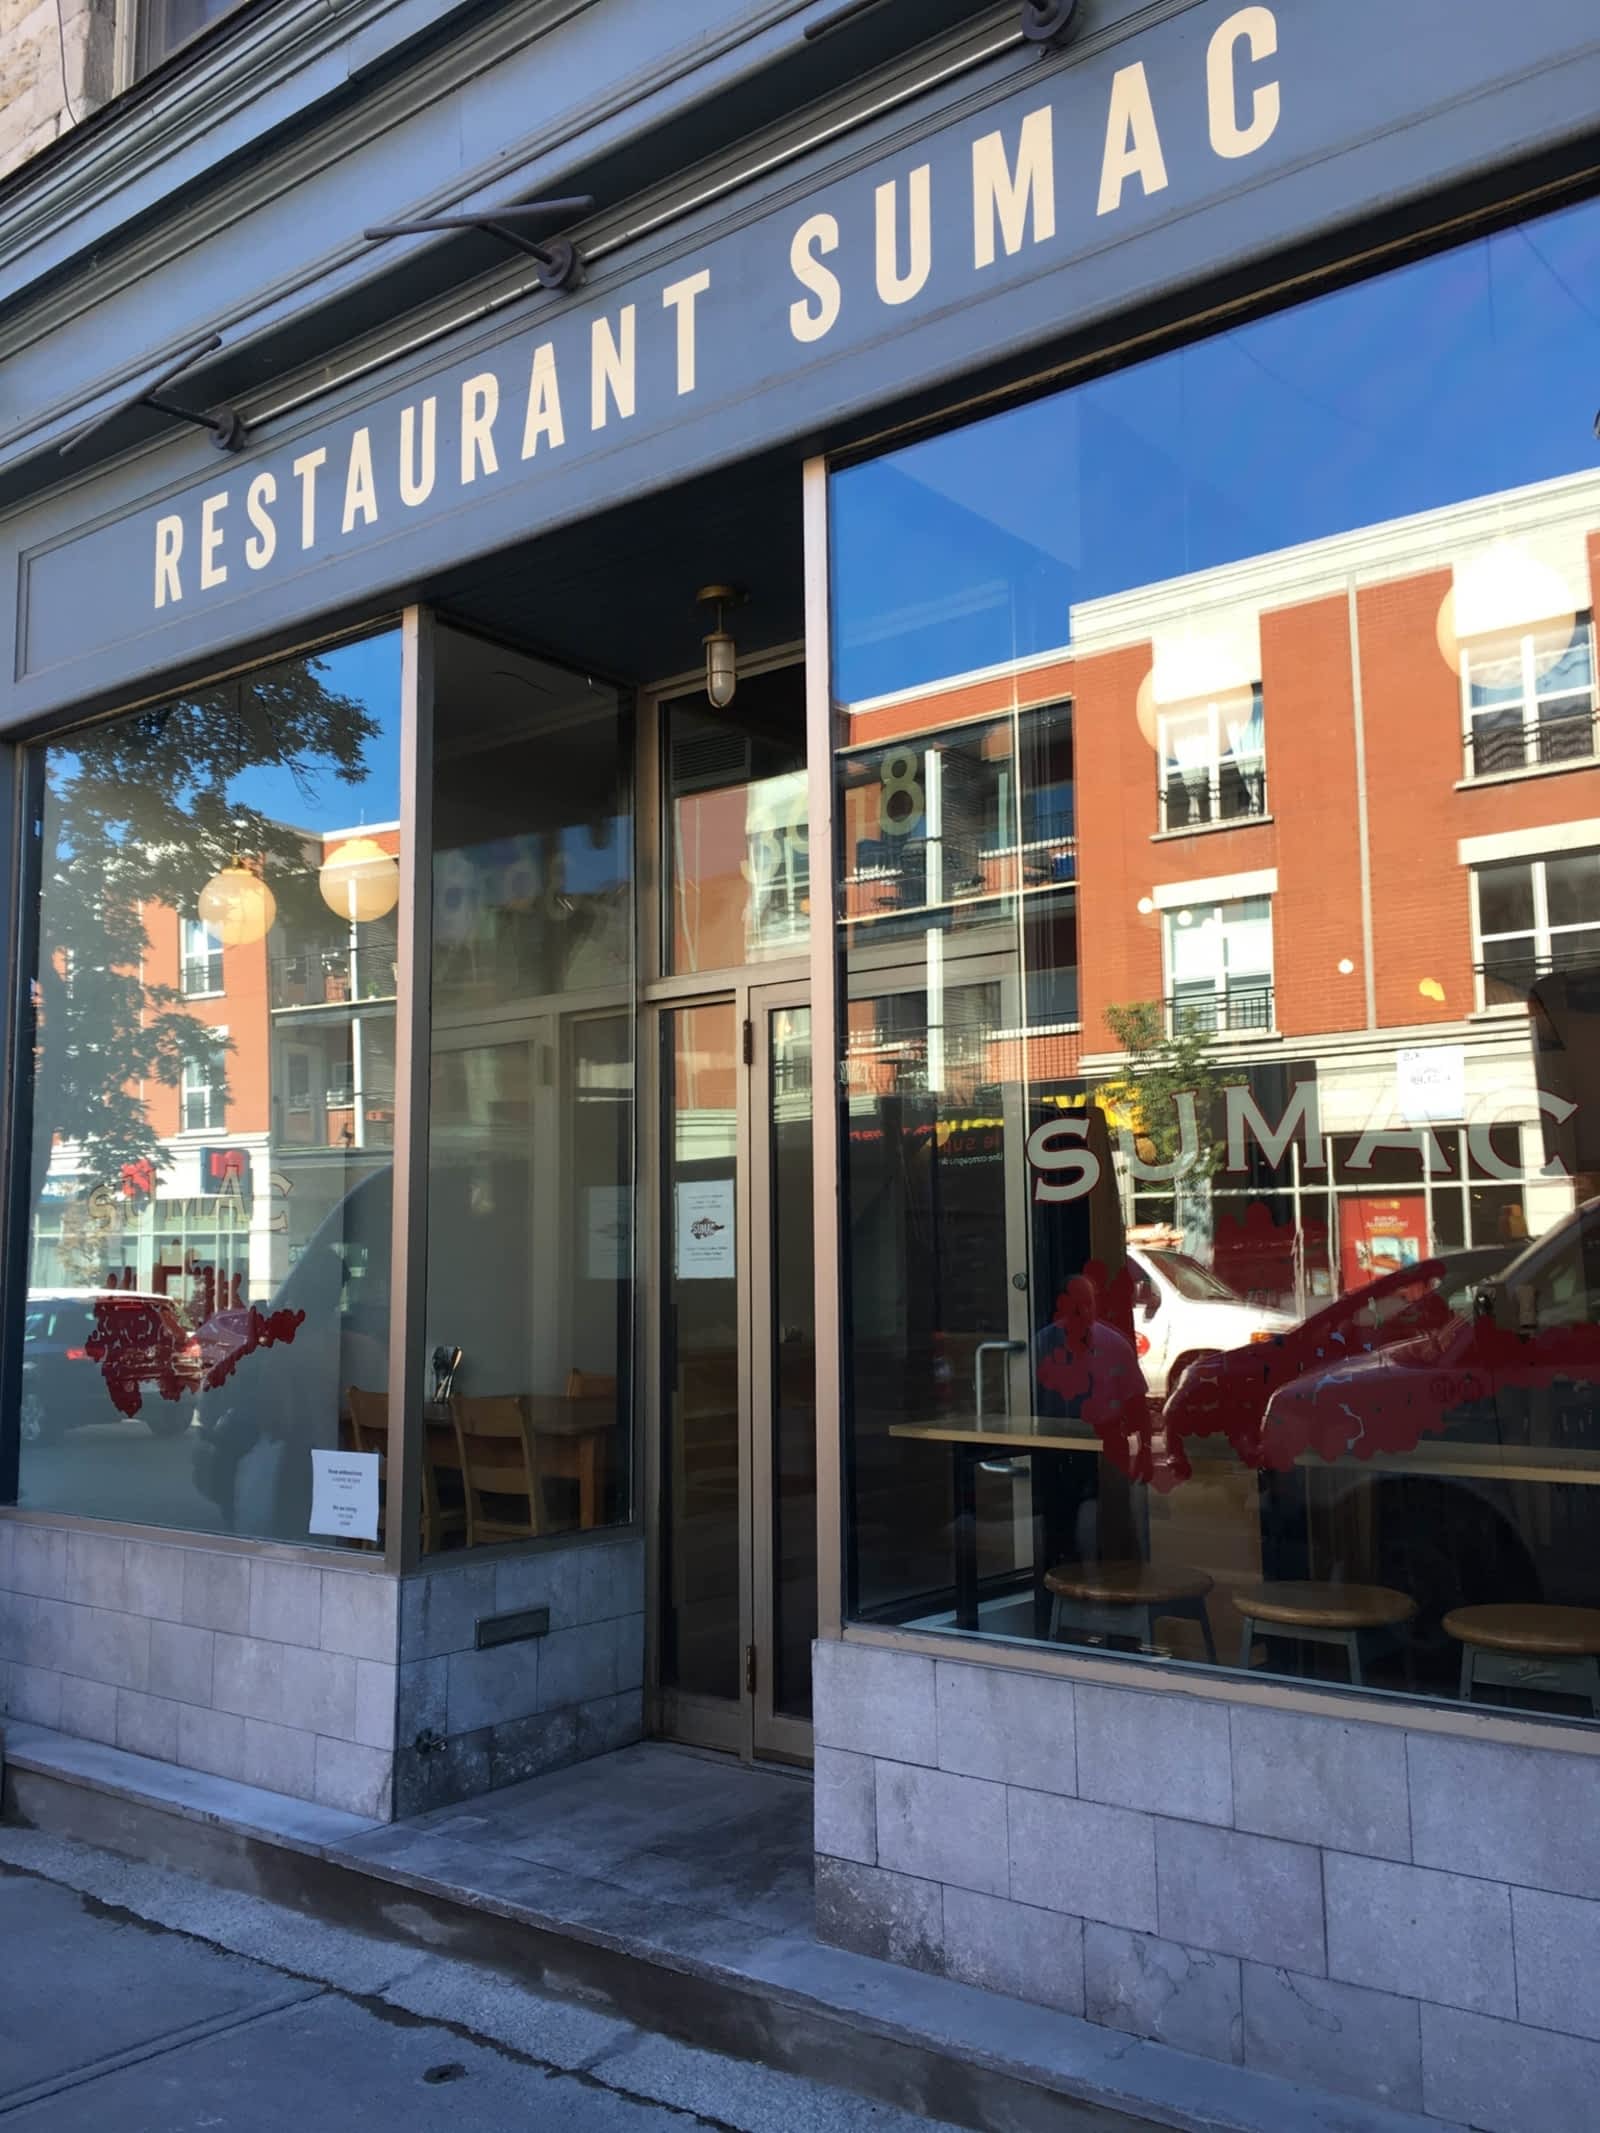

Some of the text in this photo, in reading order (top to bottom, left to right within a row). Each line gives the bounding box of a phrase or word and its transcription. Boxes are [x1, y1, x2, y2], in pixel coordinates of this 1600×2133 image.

[154, 5, 1281, 608] RESTAURANT SUMAC
[1025, 1080, 1581, 1203] SUMAC
